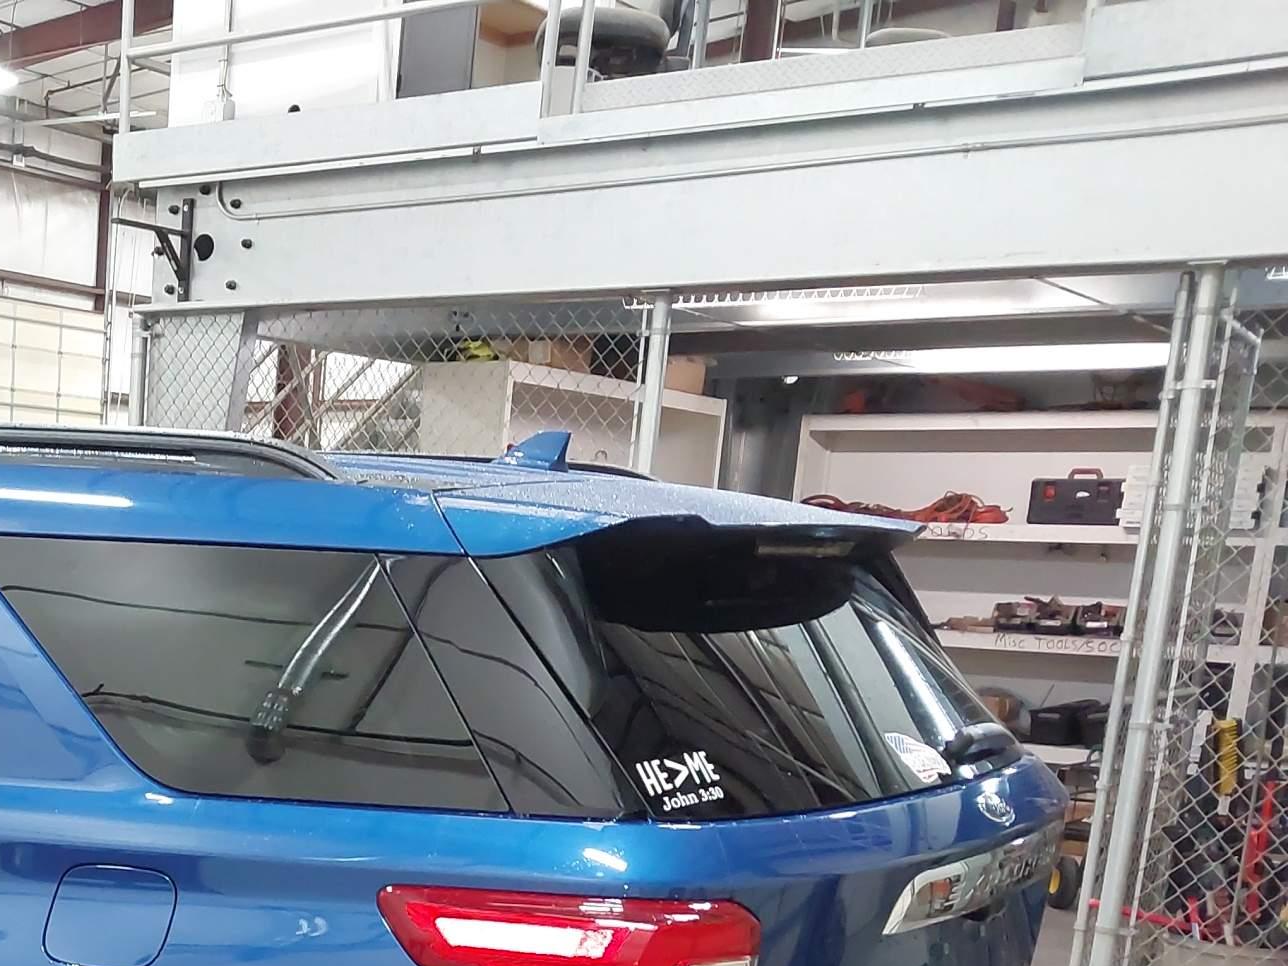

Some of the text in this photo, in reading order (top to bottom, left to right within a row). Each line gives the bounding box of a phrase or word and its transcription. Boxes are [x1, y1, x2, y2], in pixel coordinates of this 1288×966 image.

[635, 750, 721, 797] HE>ME
[662, 786, 724, 812] John 3:30
